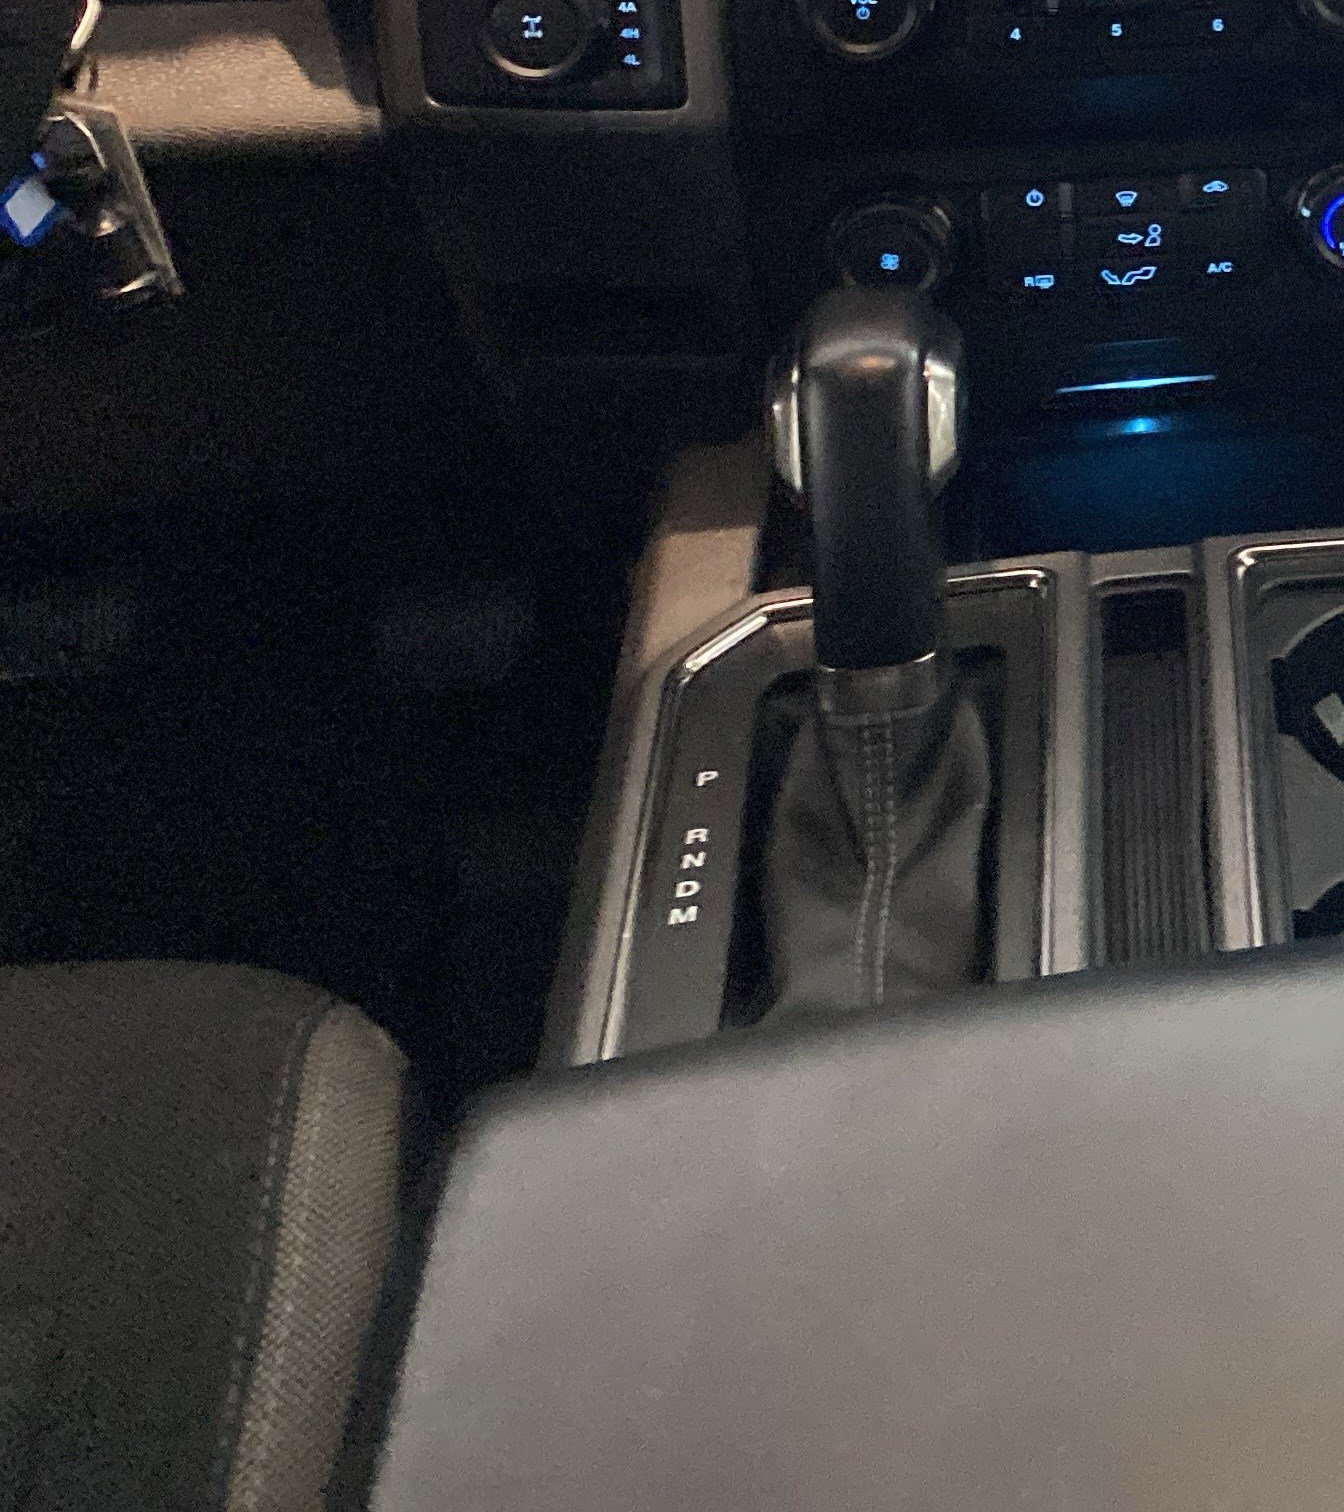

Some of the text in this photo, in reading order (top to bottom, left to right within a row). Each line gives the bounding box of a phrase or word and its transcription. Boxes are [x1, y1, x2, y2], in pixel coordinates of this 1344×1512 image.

[617, 0, 638, 13] 4A
[1110, 23, 1122, 37] 5
[1211, 18, 1224, 32] 6
[618, 26, 641, 39] 4H
[1009, 27, 1021, 41] 4
[621, 52, 642, 66] 4L
[1206, 261, 1234, 274] A/C
[695, 770, 719, 787] P
[683, 828, 709, 845] R
[680, 851, 707, 869] N
[674, 880, 701, 899] D
[667, 905, 699, 926] M
